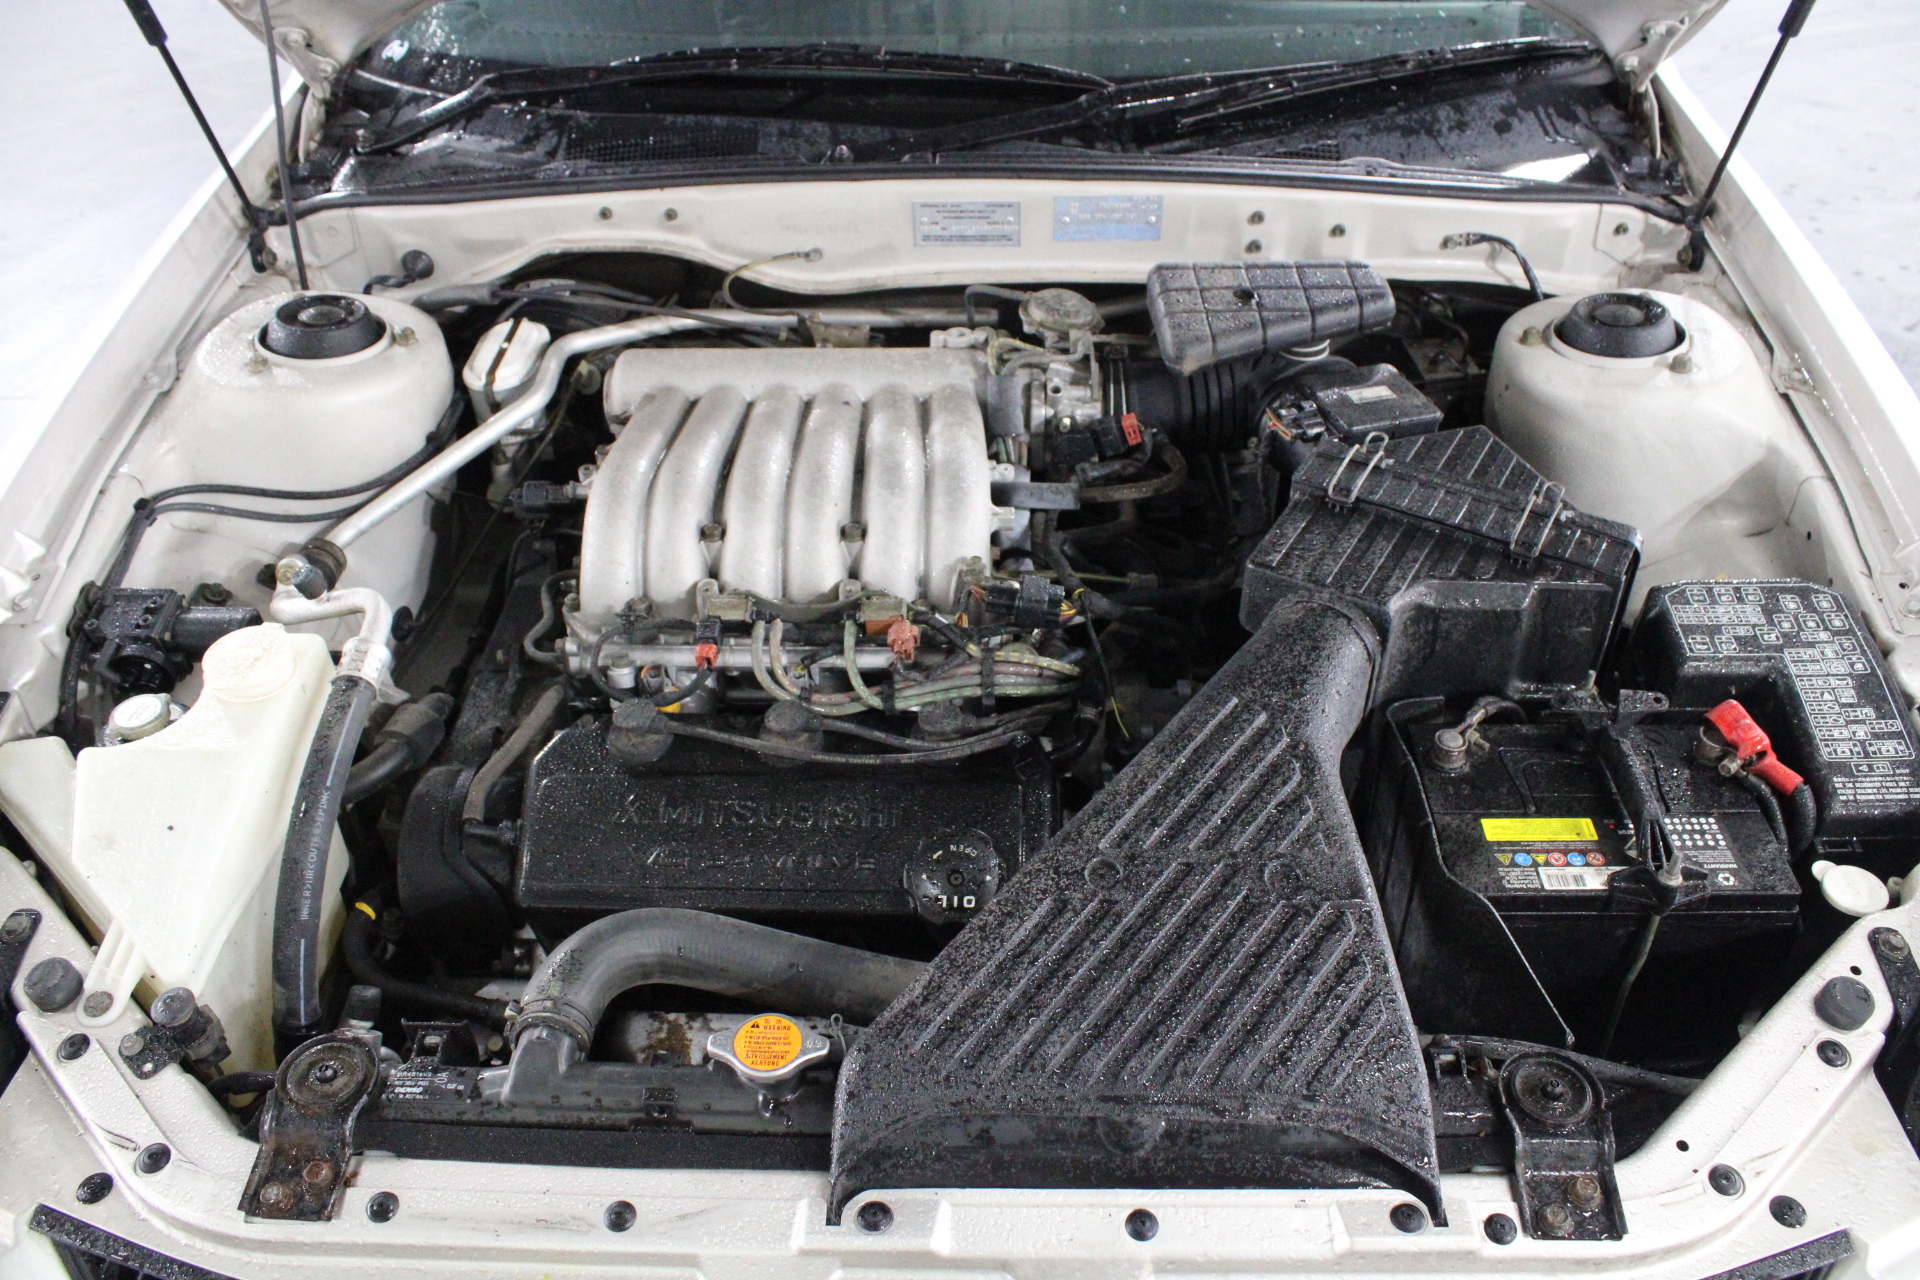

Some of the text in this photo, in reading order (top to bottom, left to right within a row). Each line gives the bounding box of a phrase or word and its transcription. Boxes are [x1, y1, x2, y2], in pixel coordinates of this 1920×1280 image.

[659, 797, 902, 829] MITSUBISHI
[950, 844, 978, 857] OPEN
[937, 894, 976, 908] OIL
